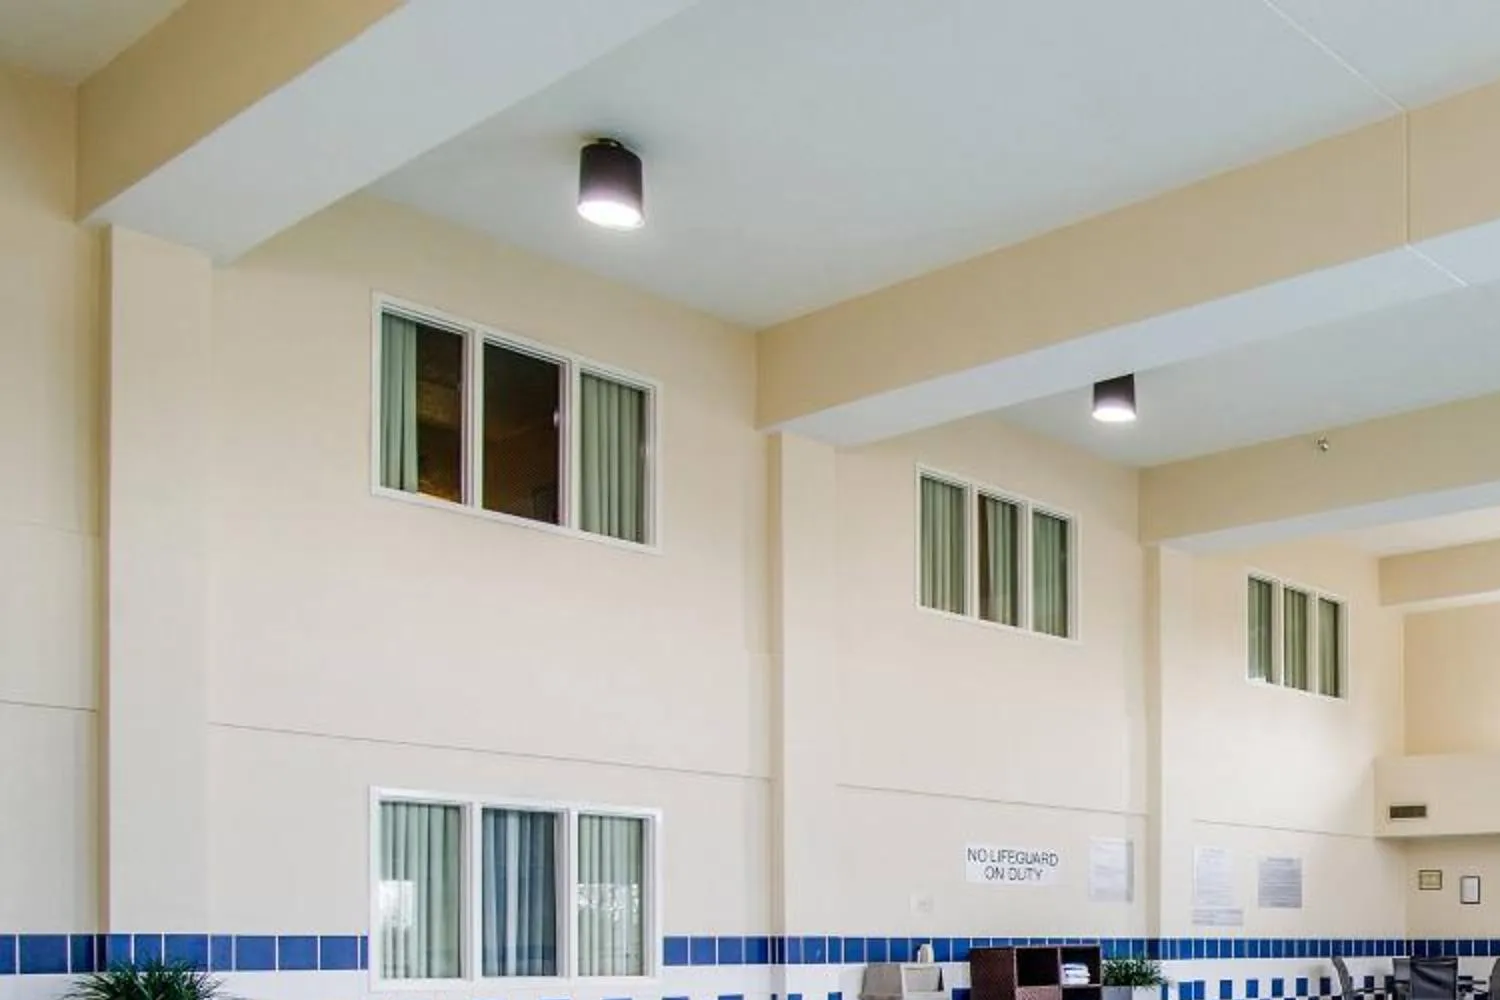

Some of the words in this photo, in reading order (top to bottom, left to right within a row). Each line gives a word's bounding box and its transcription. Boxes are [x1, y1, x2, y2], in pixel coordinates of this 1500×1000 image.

[967, 847, 987, 863] NO
[990, 849, 1059, 867] LIFEGUARD
[984, 865, 1004, 881] ON
[1007, 867, 1043, 881] DUTY
